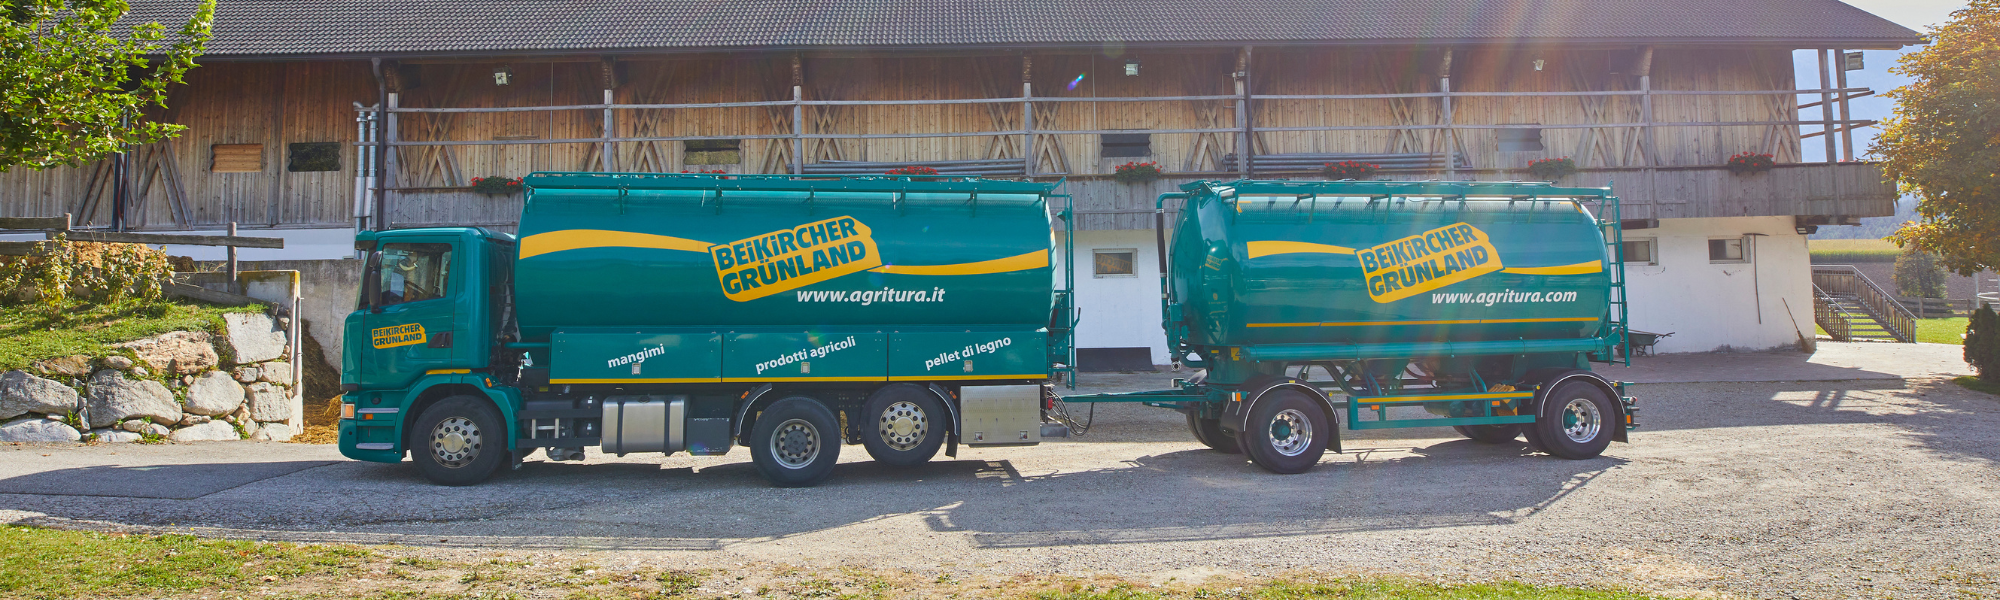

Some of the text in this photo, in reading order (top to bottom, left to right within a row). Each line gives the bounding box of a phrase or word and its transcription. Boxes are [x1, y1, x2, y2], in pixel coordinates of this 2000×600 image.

[722, 240, 867, 295] GRÜNLAND
[1368, 245, 1489, 297] GRÜNLAND
[796, 286, 946, 306] www.agritura.it
[1431, 288, 1578, 307] www.agritura.com
[607, 343, 665, 368] mangimi
[755, 335, 856, 375] prodotti agricoli
[925, 336, 1012, 371] pellet di legno
